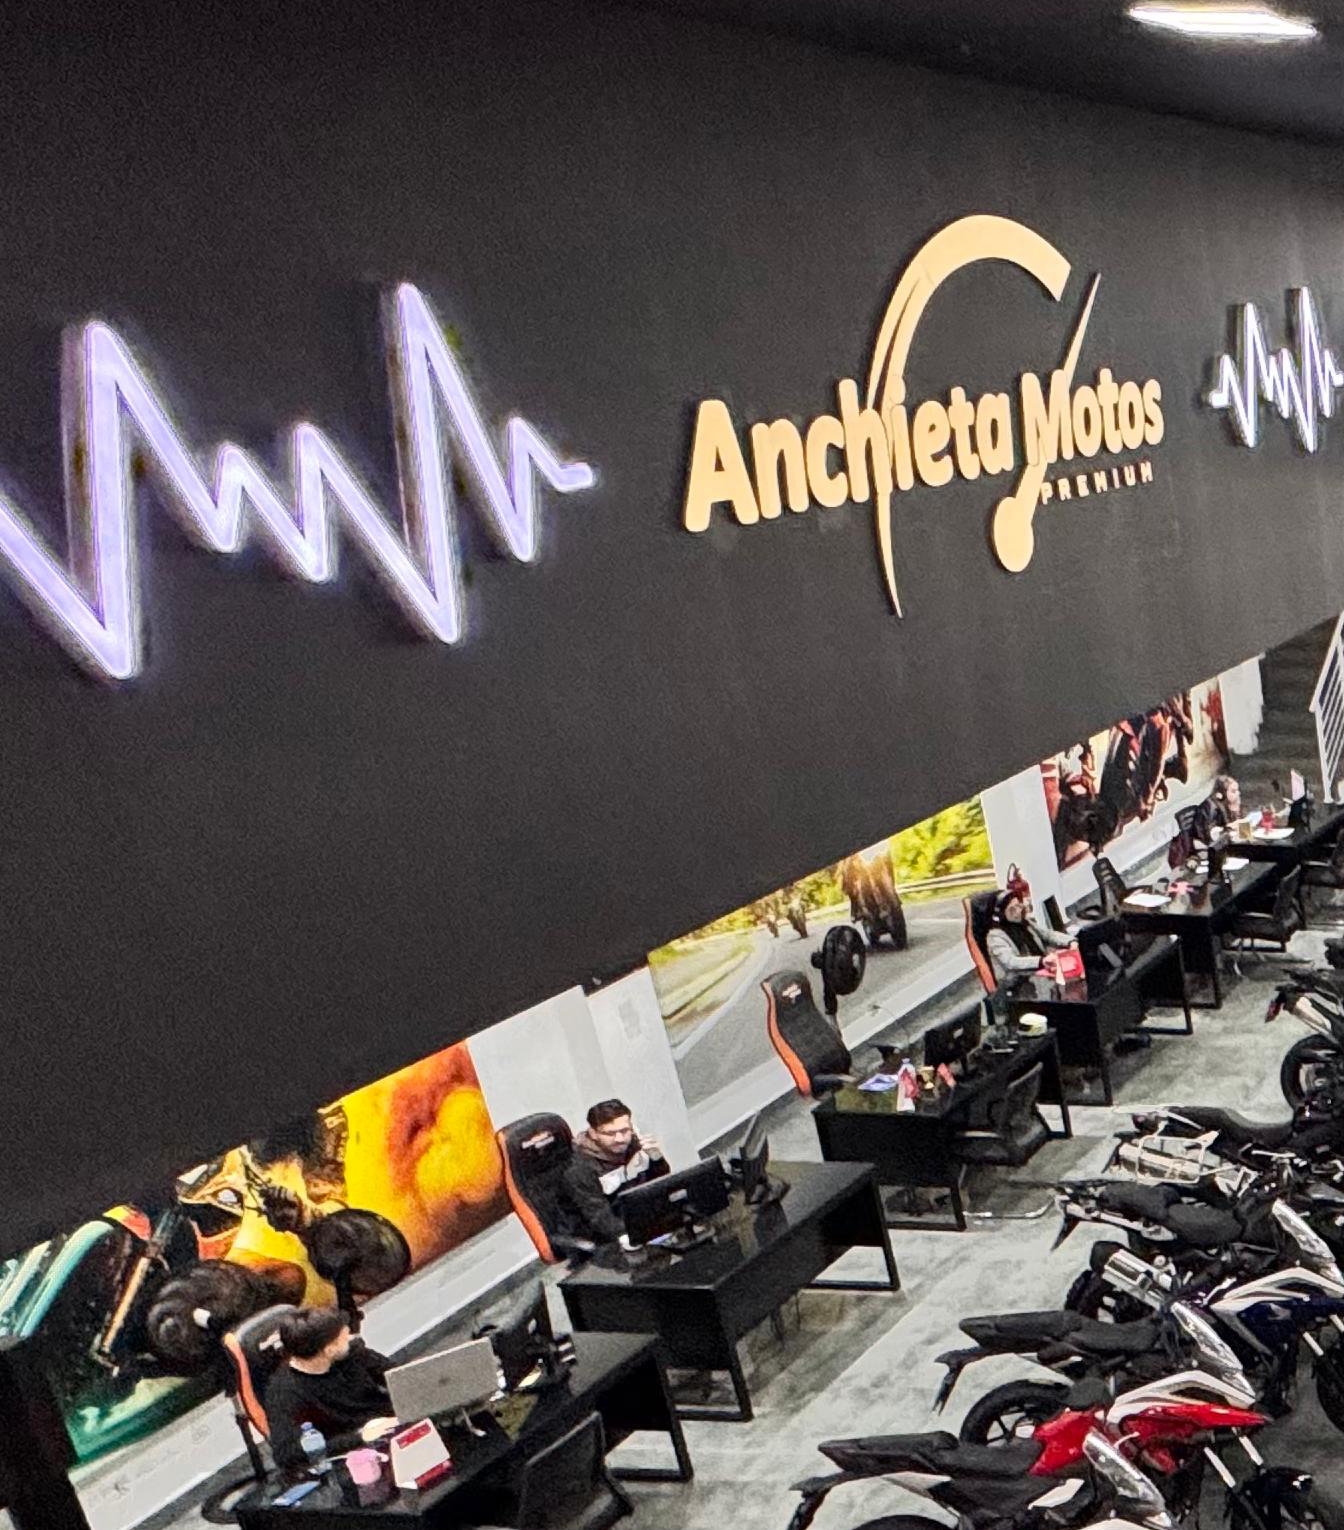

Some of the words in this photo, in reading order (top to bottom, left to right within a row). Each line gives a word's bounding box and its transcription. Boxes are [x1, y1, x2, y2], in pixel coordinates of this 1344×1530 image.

[685, 378, 1014, 533] Anchieta
[1021, 368, 1165, 466] Motos
[1041, 461, 1154, 504] PREMIUM
